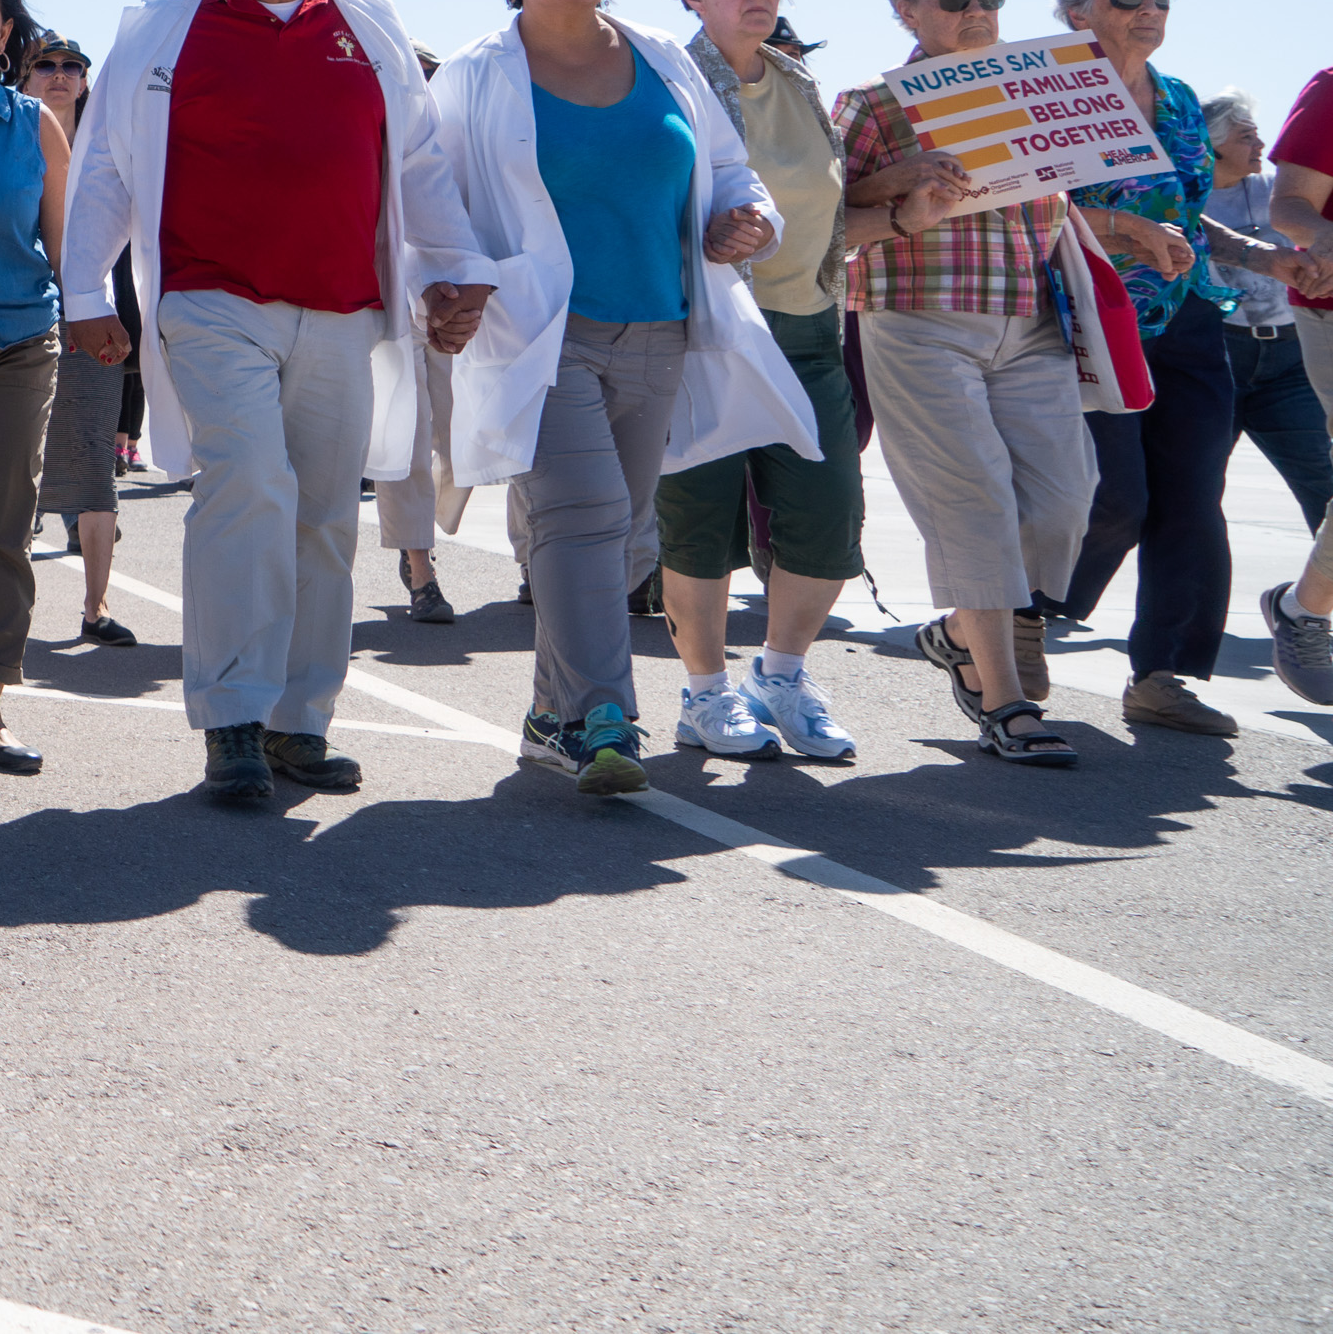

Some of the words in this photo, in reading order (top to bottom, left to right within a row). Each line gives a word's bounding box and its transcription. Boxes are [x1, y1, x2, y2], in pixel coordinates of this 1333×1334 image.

[900, 58, 1004, 96] NURSES
[1005, 50, 1049, 72] SAY
[1002, 68, 1110, 100] FAMILIES
[1029, 93, 1125, 124] BELONG
[1011, 118, 1143, 156] TOGETHER
[1103, 148, 1131, 158] HEAL
[1113, 152, 1156, 166] AMERICA
[989, 175, 1011, 185] National
[1011, 172, 1029, 180] Nurses
[990, 180, 1020, 190] Organizing
[992, 185, 1022, 195] Committee
